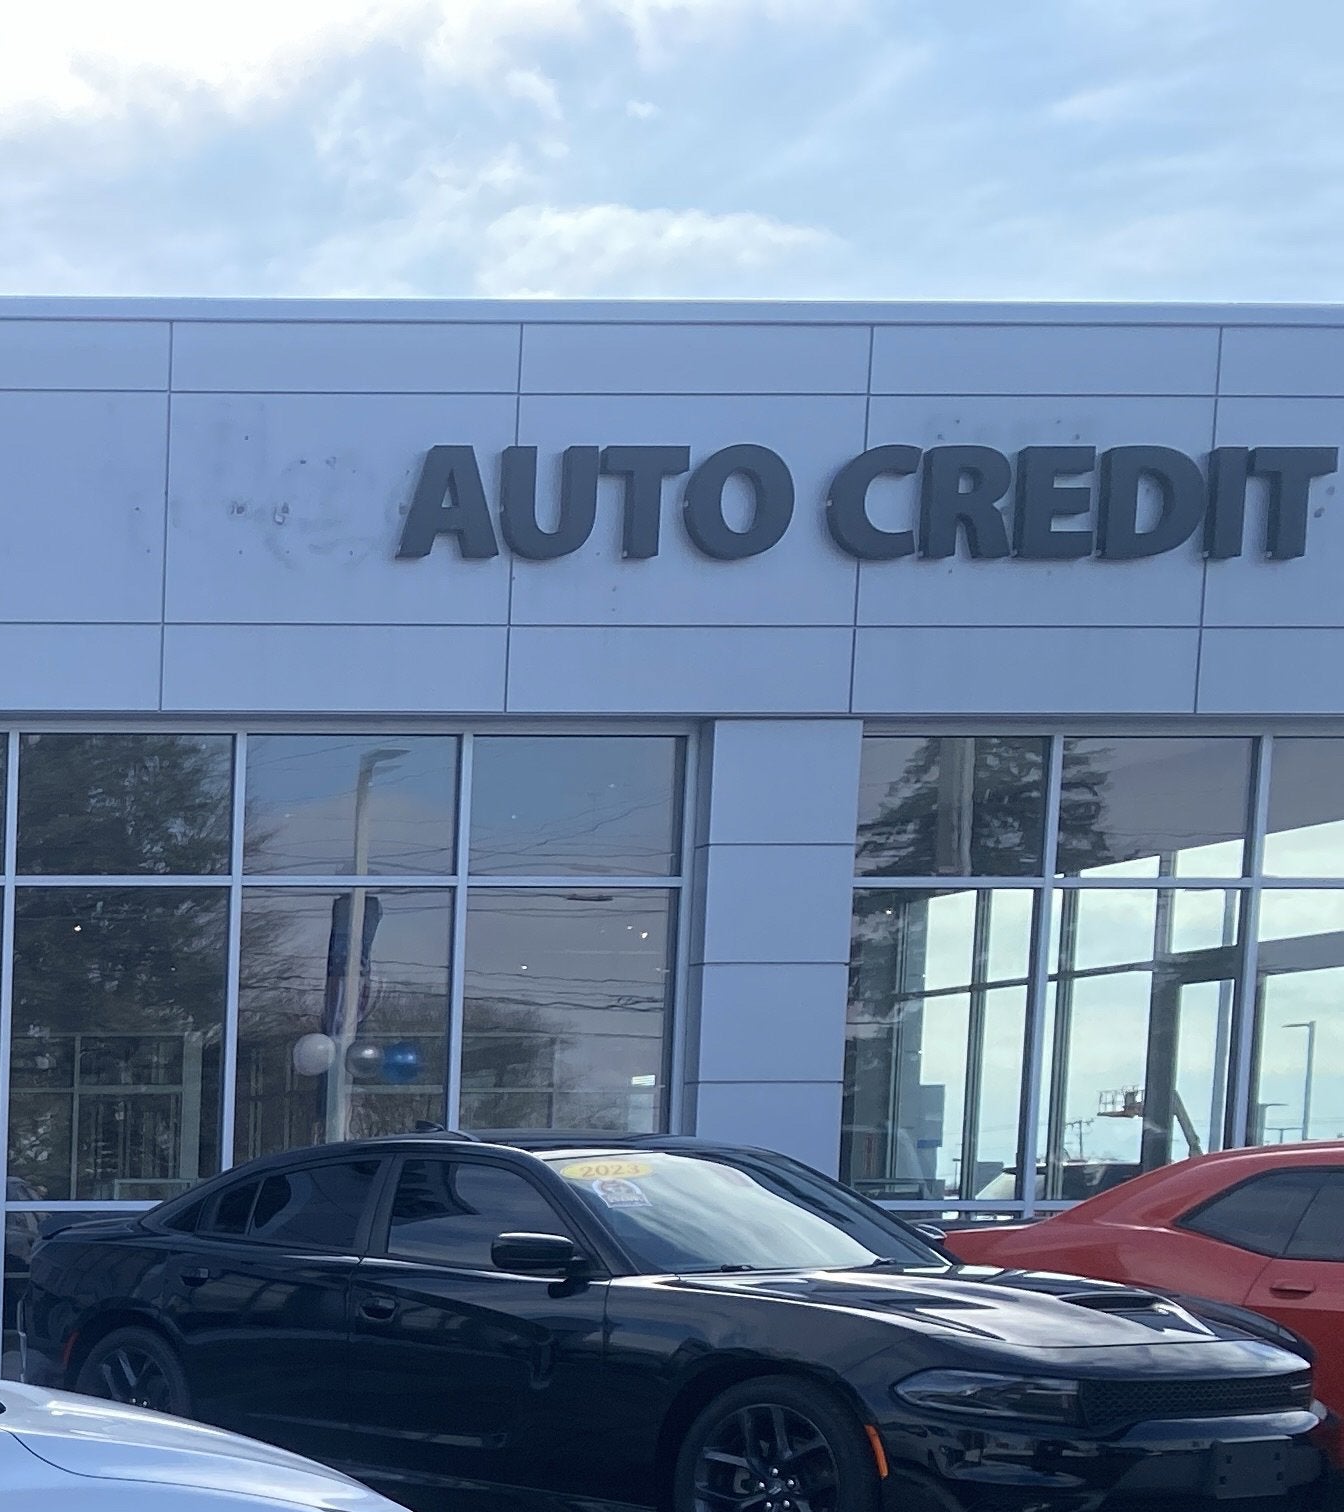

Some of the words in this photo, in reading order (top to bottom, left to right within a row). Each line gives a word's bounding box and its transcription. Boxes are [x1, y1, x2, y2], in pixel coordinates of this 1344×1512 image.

[395, 443, 796, 560] AUTO
[826, 443, 1339, 560] CREDIT
[580, 1164, 641, 1177] 2023
